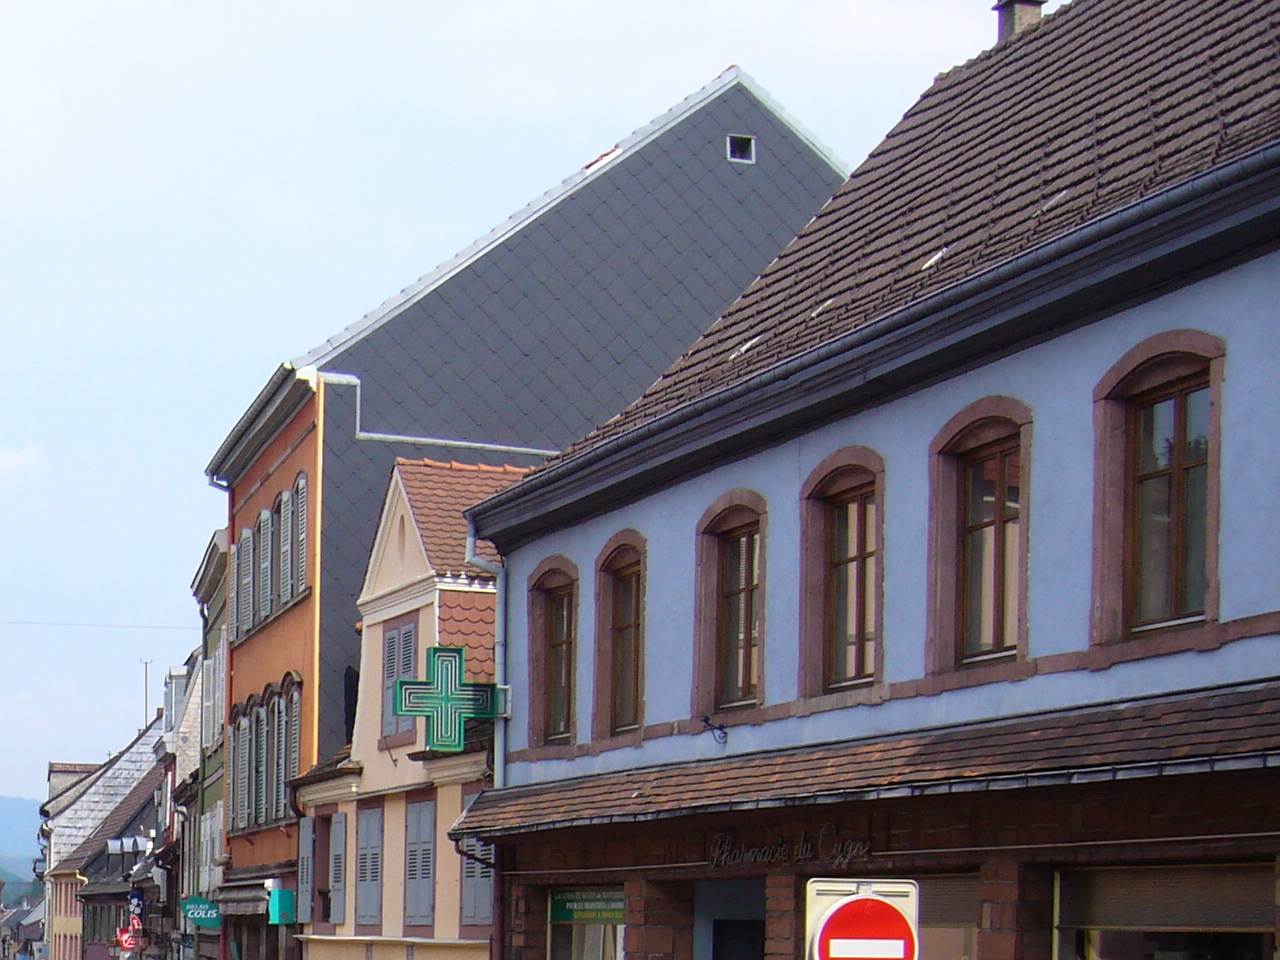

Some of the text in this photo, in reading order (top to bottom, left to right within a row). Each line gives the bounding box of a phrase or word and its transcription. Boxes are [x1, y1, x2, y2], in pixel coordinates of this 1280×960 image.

[708, 832, 789, 868] Pharmacie
[794, 831, 813, 859] du
[187, 909, 218, 919] COLIS
